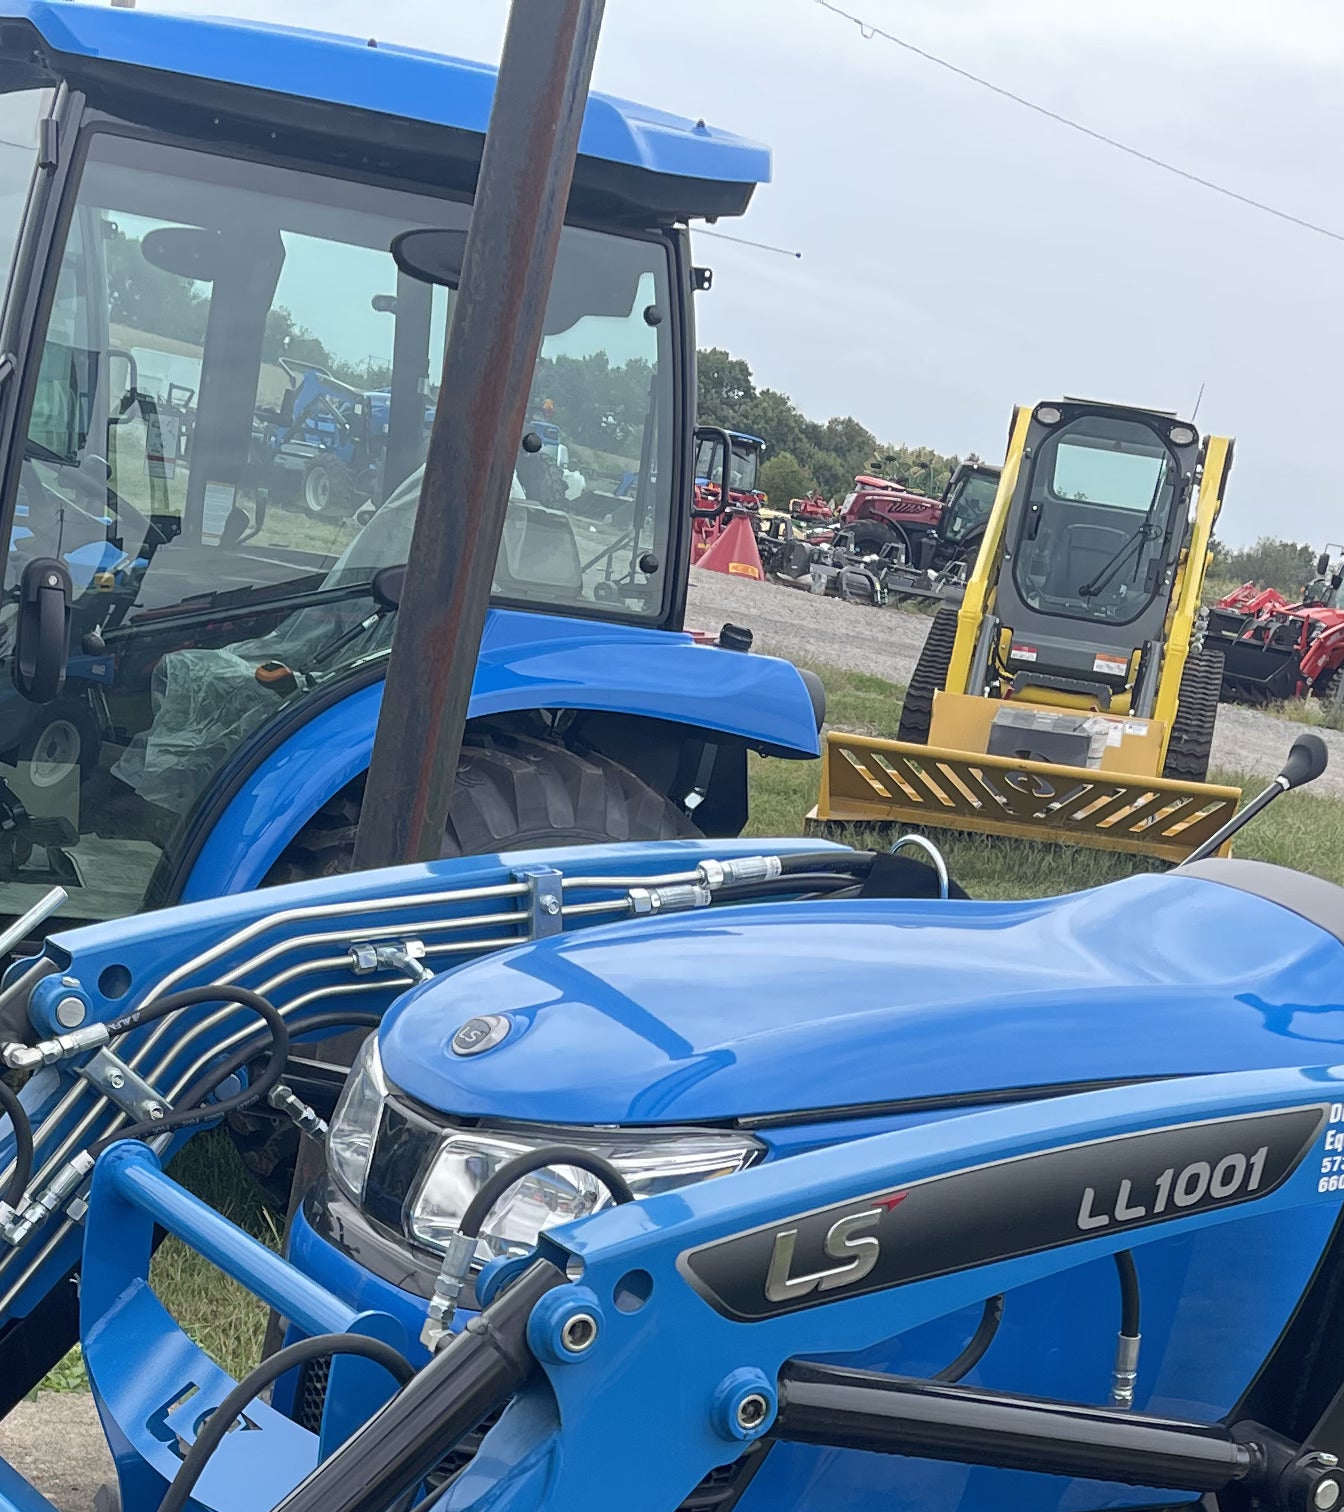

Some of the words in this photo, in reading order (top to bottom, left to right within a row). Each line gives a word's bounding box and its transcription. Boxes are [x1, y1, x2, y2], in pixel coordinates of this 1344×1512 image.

[459, 1026, 482, 1042] LS
[1076, 1146, 1272, 1231] LL1001
[765, 1207, 883, 1303] LS
